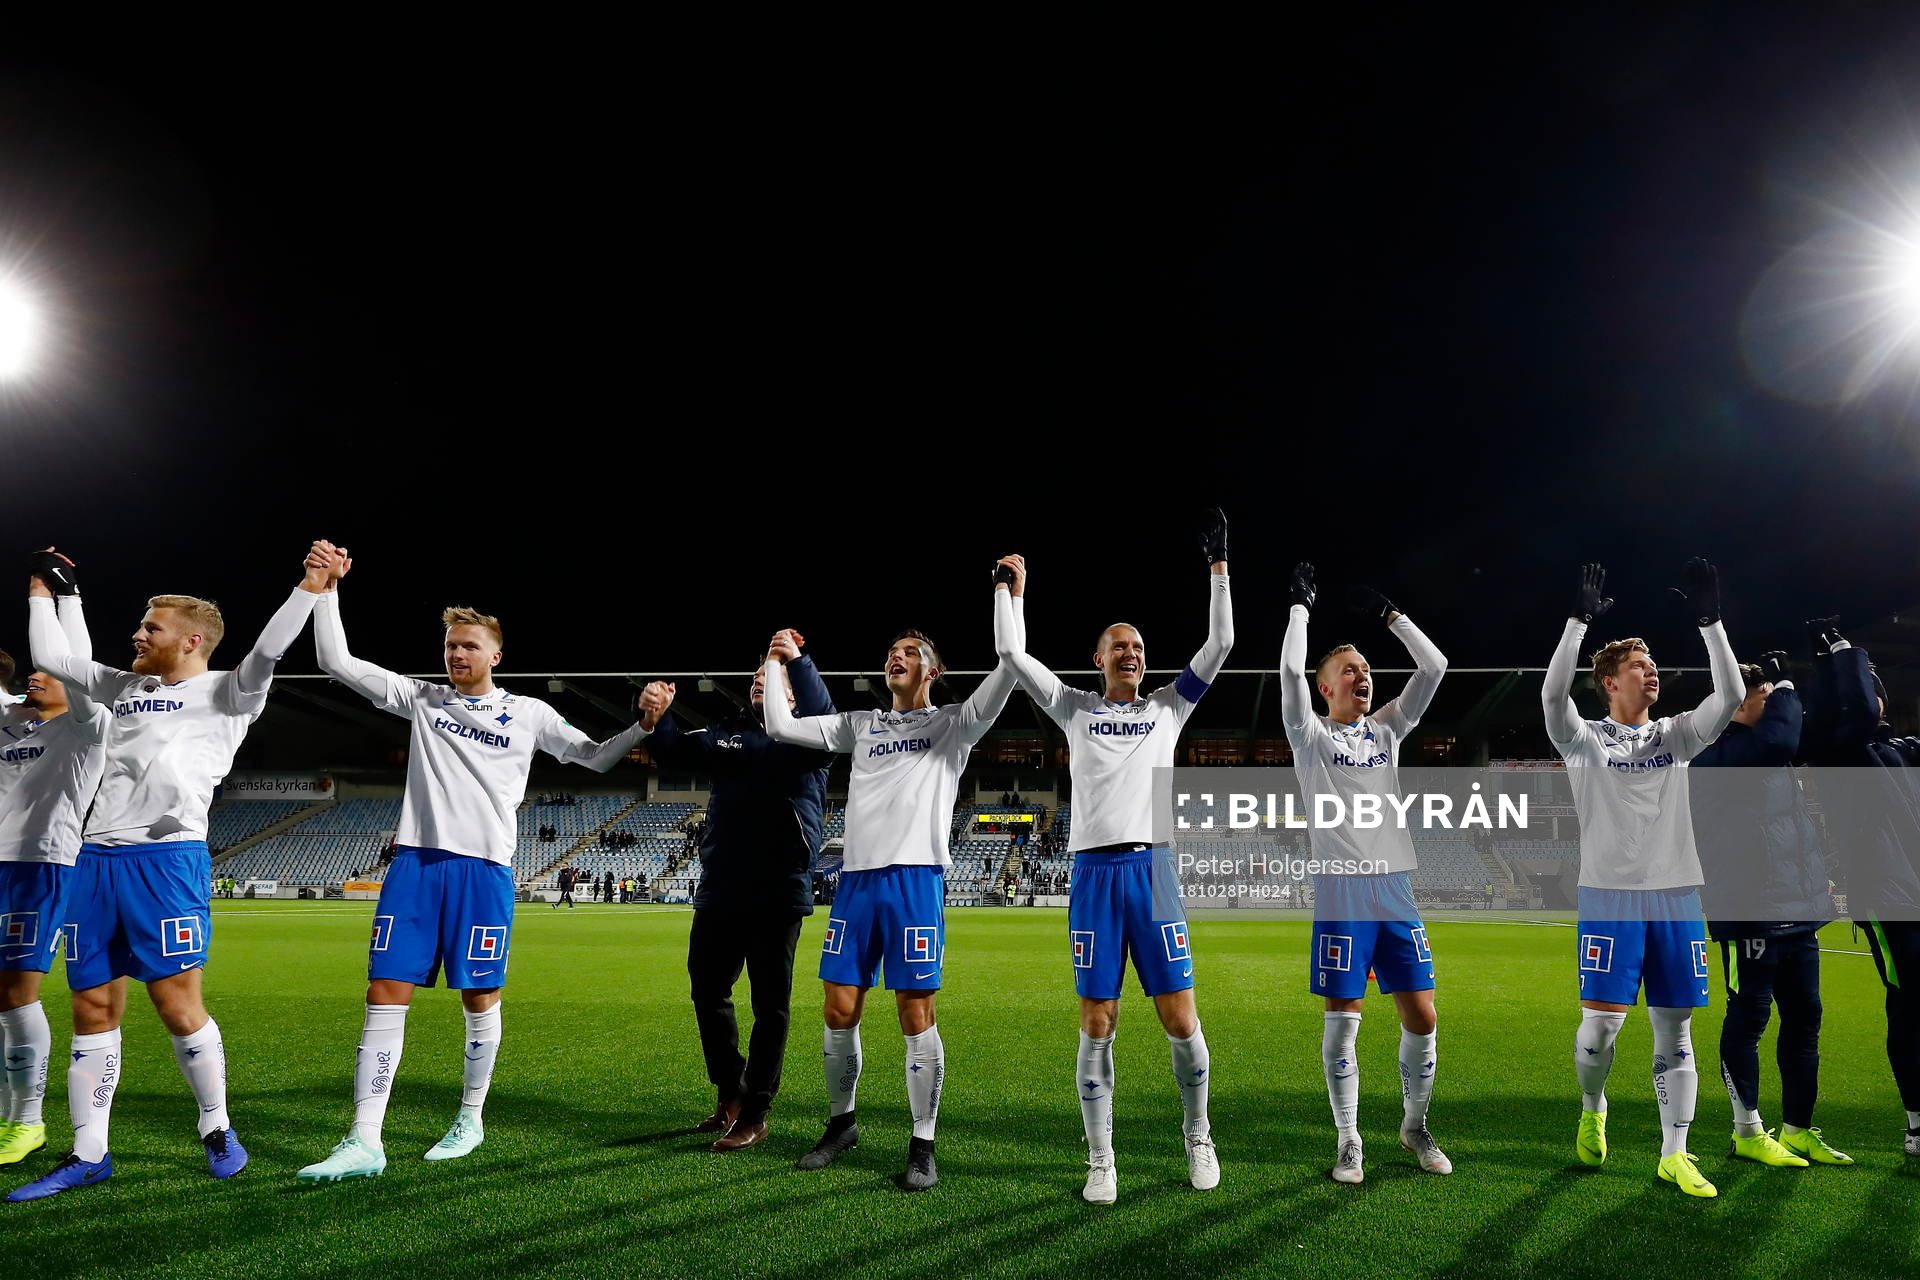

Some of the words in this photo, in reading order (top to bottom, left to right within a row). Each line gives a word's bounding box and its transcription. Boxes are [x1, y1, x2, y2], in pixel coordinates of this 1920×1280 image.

[115, 699, 184, 718] HOLMEN
[434, 718, 511, 748] HOLMEN
[1088, 721, 1156, 736] HOLMEN
[868, 738, 932, 758] HOLMEN
[1333, 750, 1389, 768] HOMEN
[226, 779, 273, 791] Svenska
[275, 779, 316, 793] kyrkan
[1742, 938, 1766, 959] 19
[1319, 971, 1327, 988] 8
[102, 1052, 118, 1084] suez
[376, 1050, 391, 1075] suez
[1654, 1075, 1668, 1106] suez
